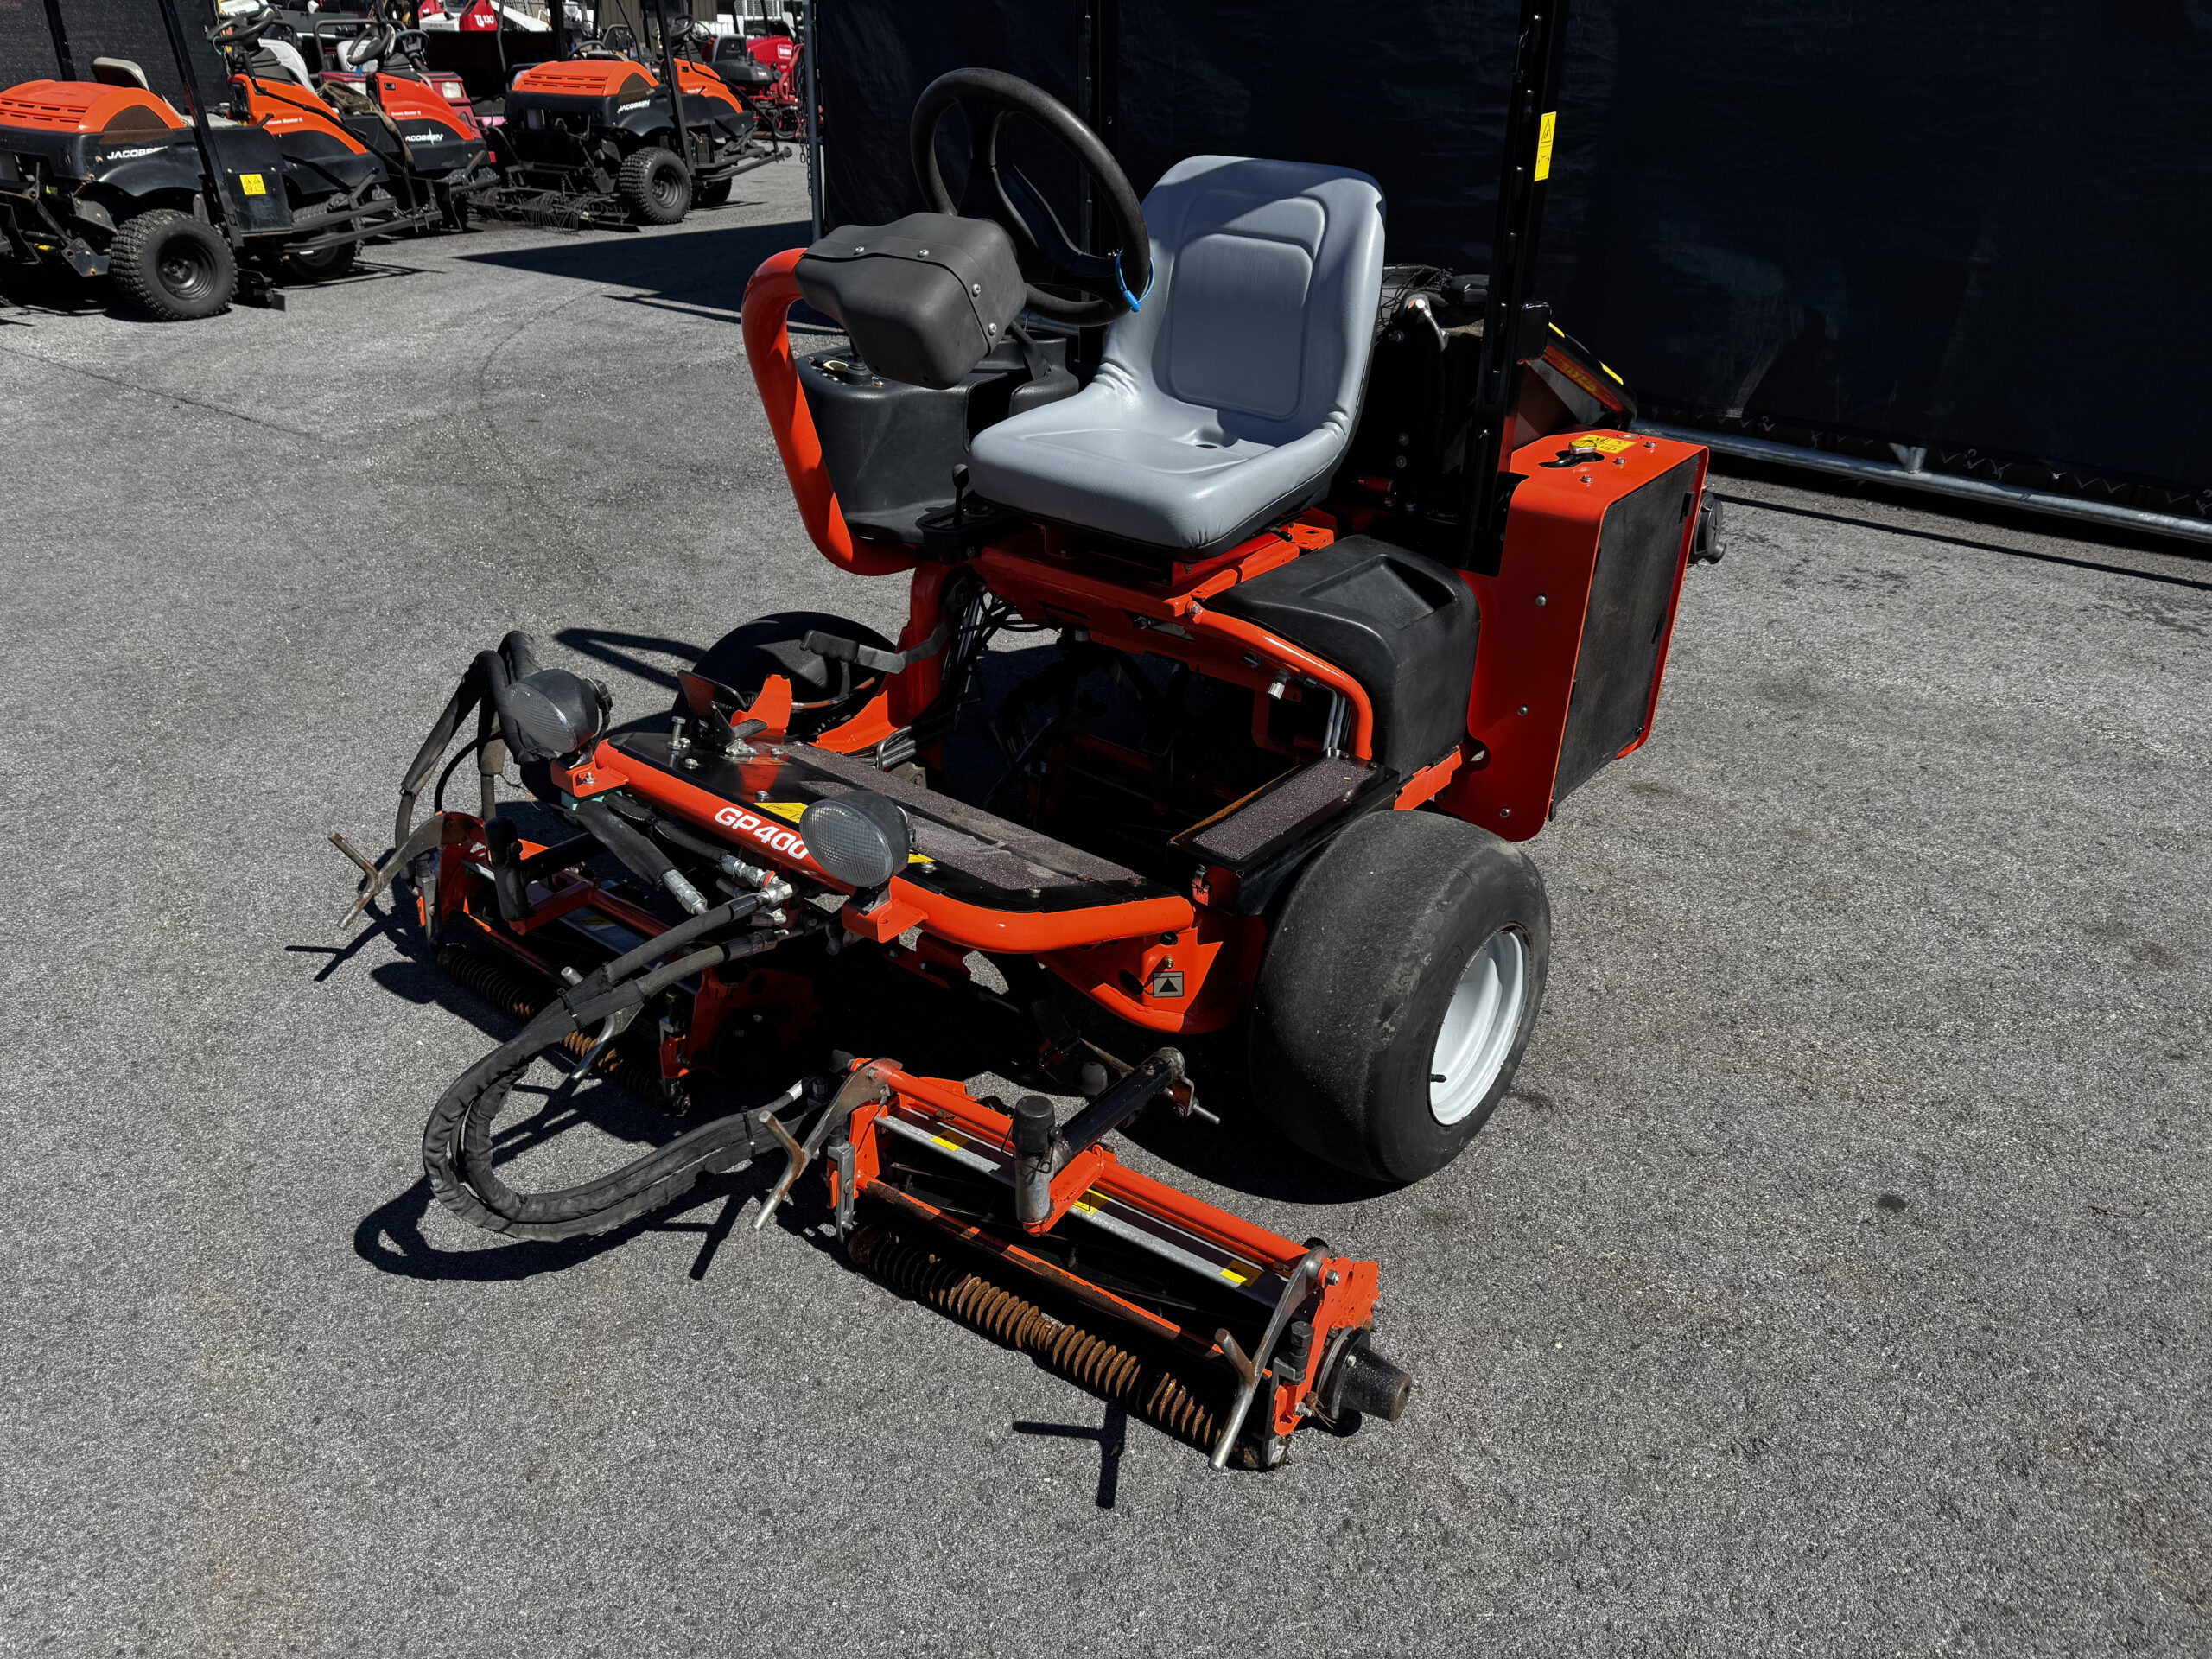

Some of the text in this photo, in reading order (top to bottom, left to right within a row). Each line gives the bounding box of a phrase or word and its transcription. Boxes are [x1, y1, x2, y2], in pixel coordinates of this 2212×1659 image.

[617, 99, 651, 114] JACOBSEN
[404, 133, 444, 142] ACOBSEN
[714, 806, 810, 860] GP400
